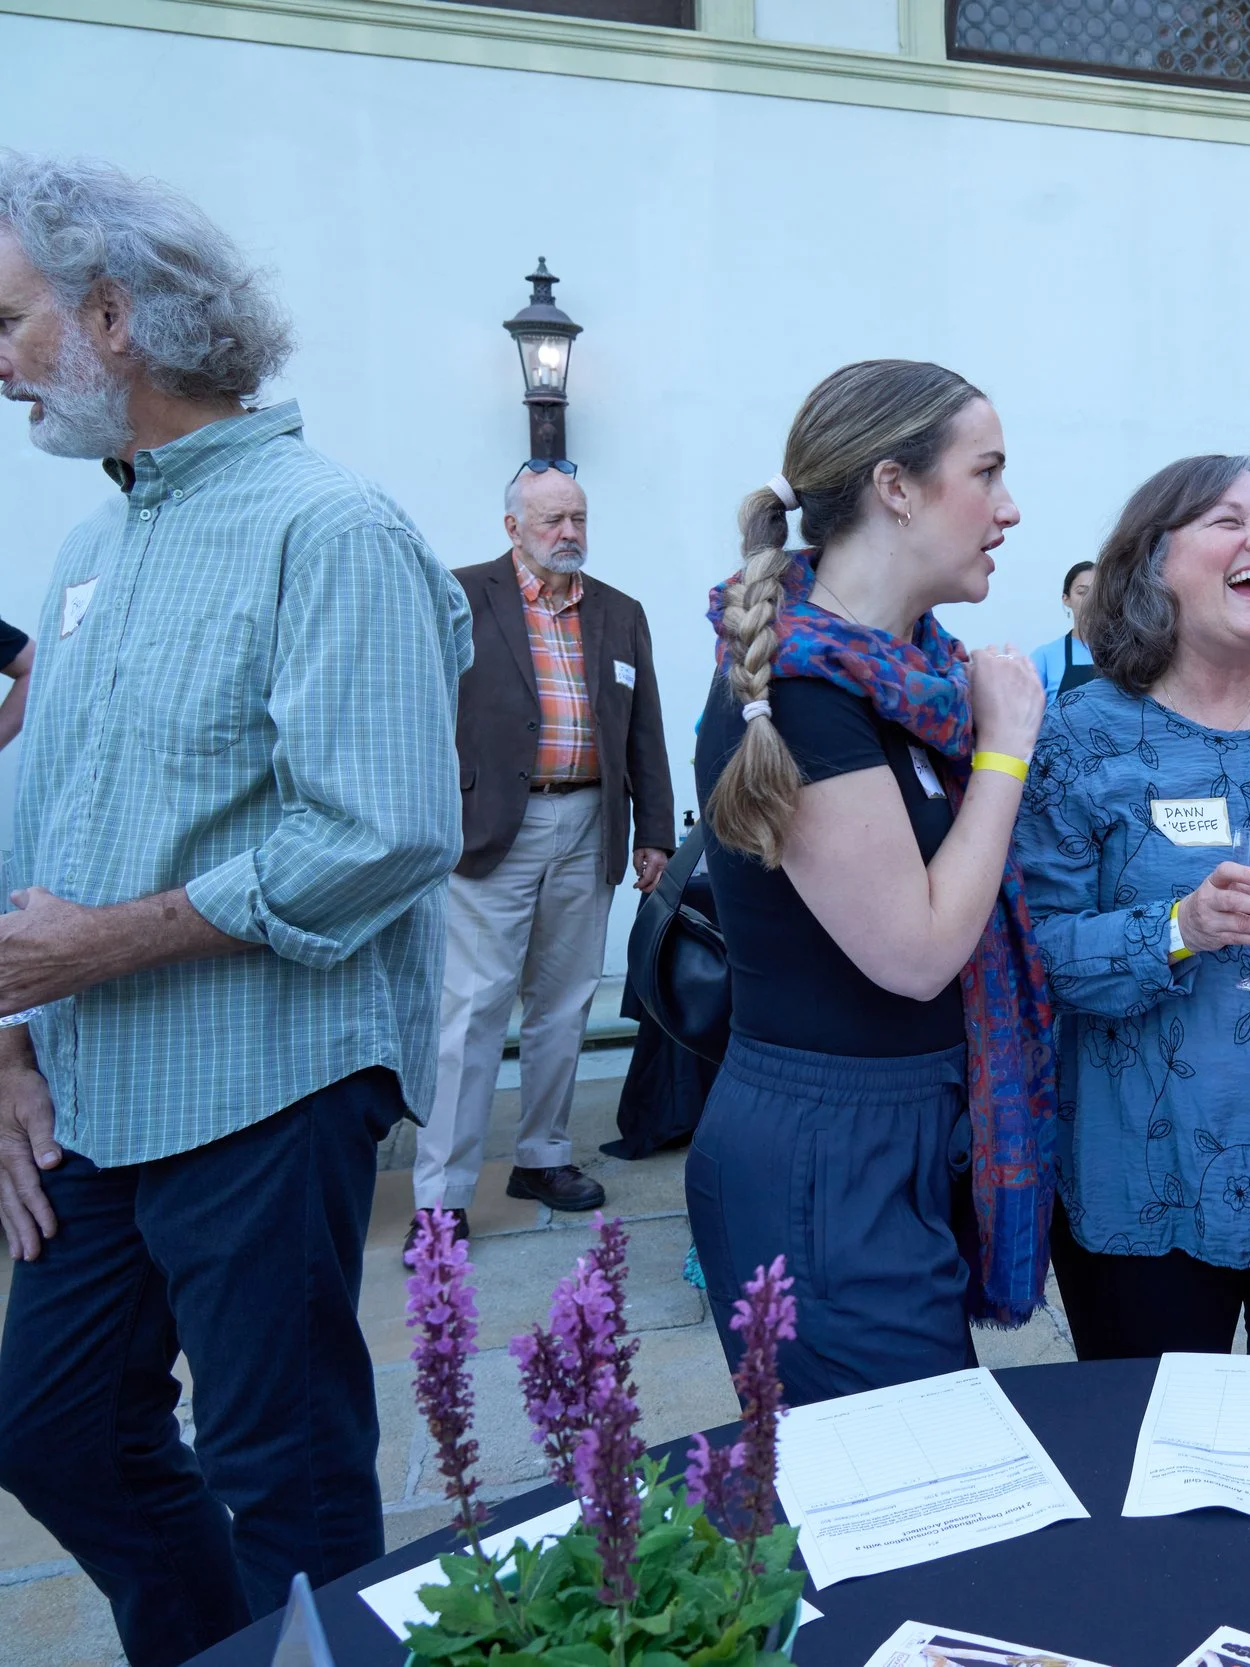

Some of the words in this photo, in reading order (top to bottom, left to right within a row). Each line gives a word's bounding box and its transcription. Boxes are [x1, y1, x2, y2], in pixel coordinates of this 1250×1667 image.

[1164, 807, 1204, 819] DAWN
[1203, 1477, 1242, 1493] American
[1005, 1504, 1025, 1515] Hour
[941, 1512, 1003, 1532] Design/Budget
[943, 1512, 982, 1526] Licensed
[903, 1522, 941, 1536] Architect
[883, 1529, 939, 1546] Consultation
